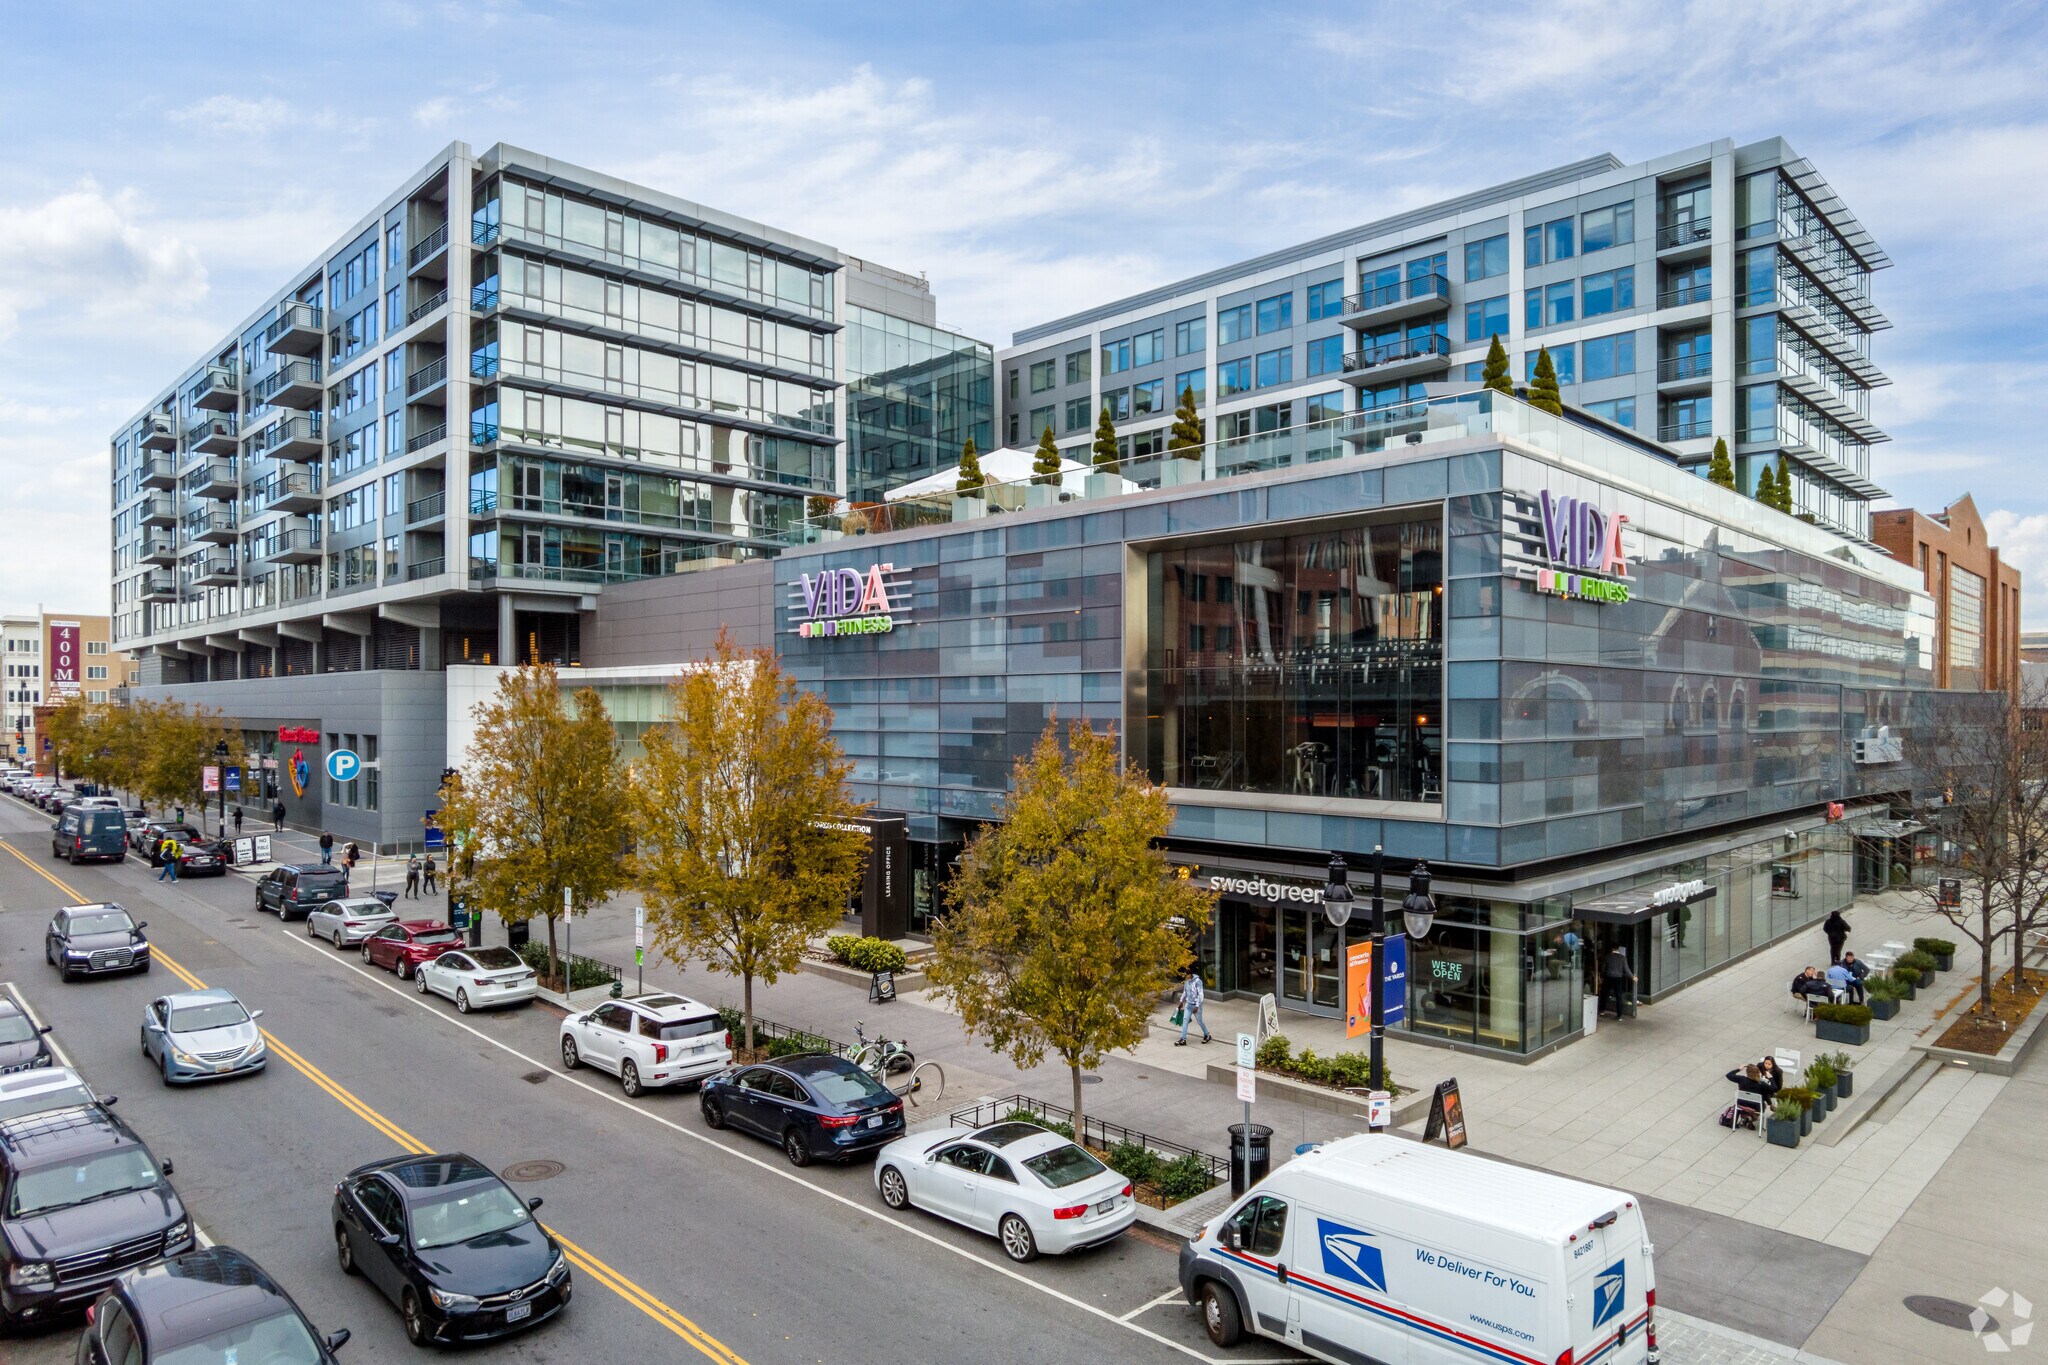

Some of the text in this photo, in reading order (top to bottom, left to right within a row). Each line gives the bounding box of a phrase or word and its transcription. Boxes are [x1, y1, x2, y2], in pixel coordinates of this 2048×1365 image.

[1538, 489, 1628, 577] VIDA
[800, 564, 891, 619] VIDA
[1581, 577, 1630, 604] FITNESS
[837, 616, 892, 635] FITNESS
[336, 755, 355, 776] P
[1210, 876, 1327, 905] sweetgreen
[1349, 952, 1370, 961] concerts
[1431, 959, 1462, 973] WE'RE
[1433, 968, 1461, 981] OPEN
[1243, 1039, 1250, 1048] P
[1416, 1248, 1536, 1298] We Deliver For You.
[1469, 1313, 1535, 1342] www.usps.com
